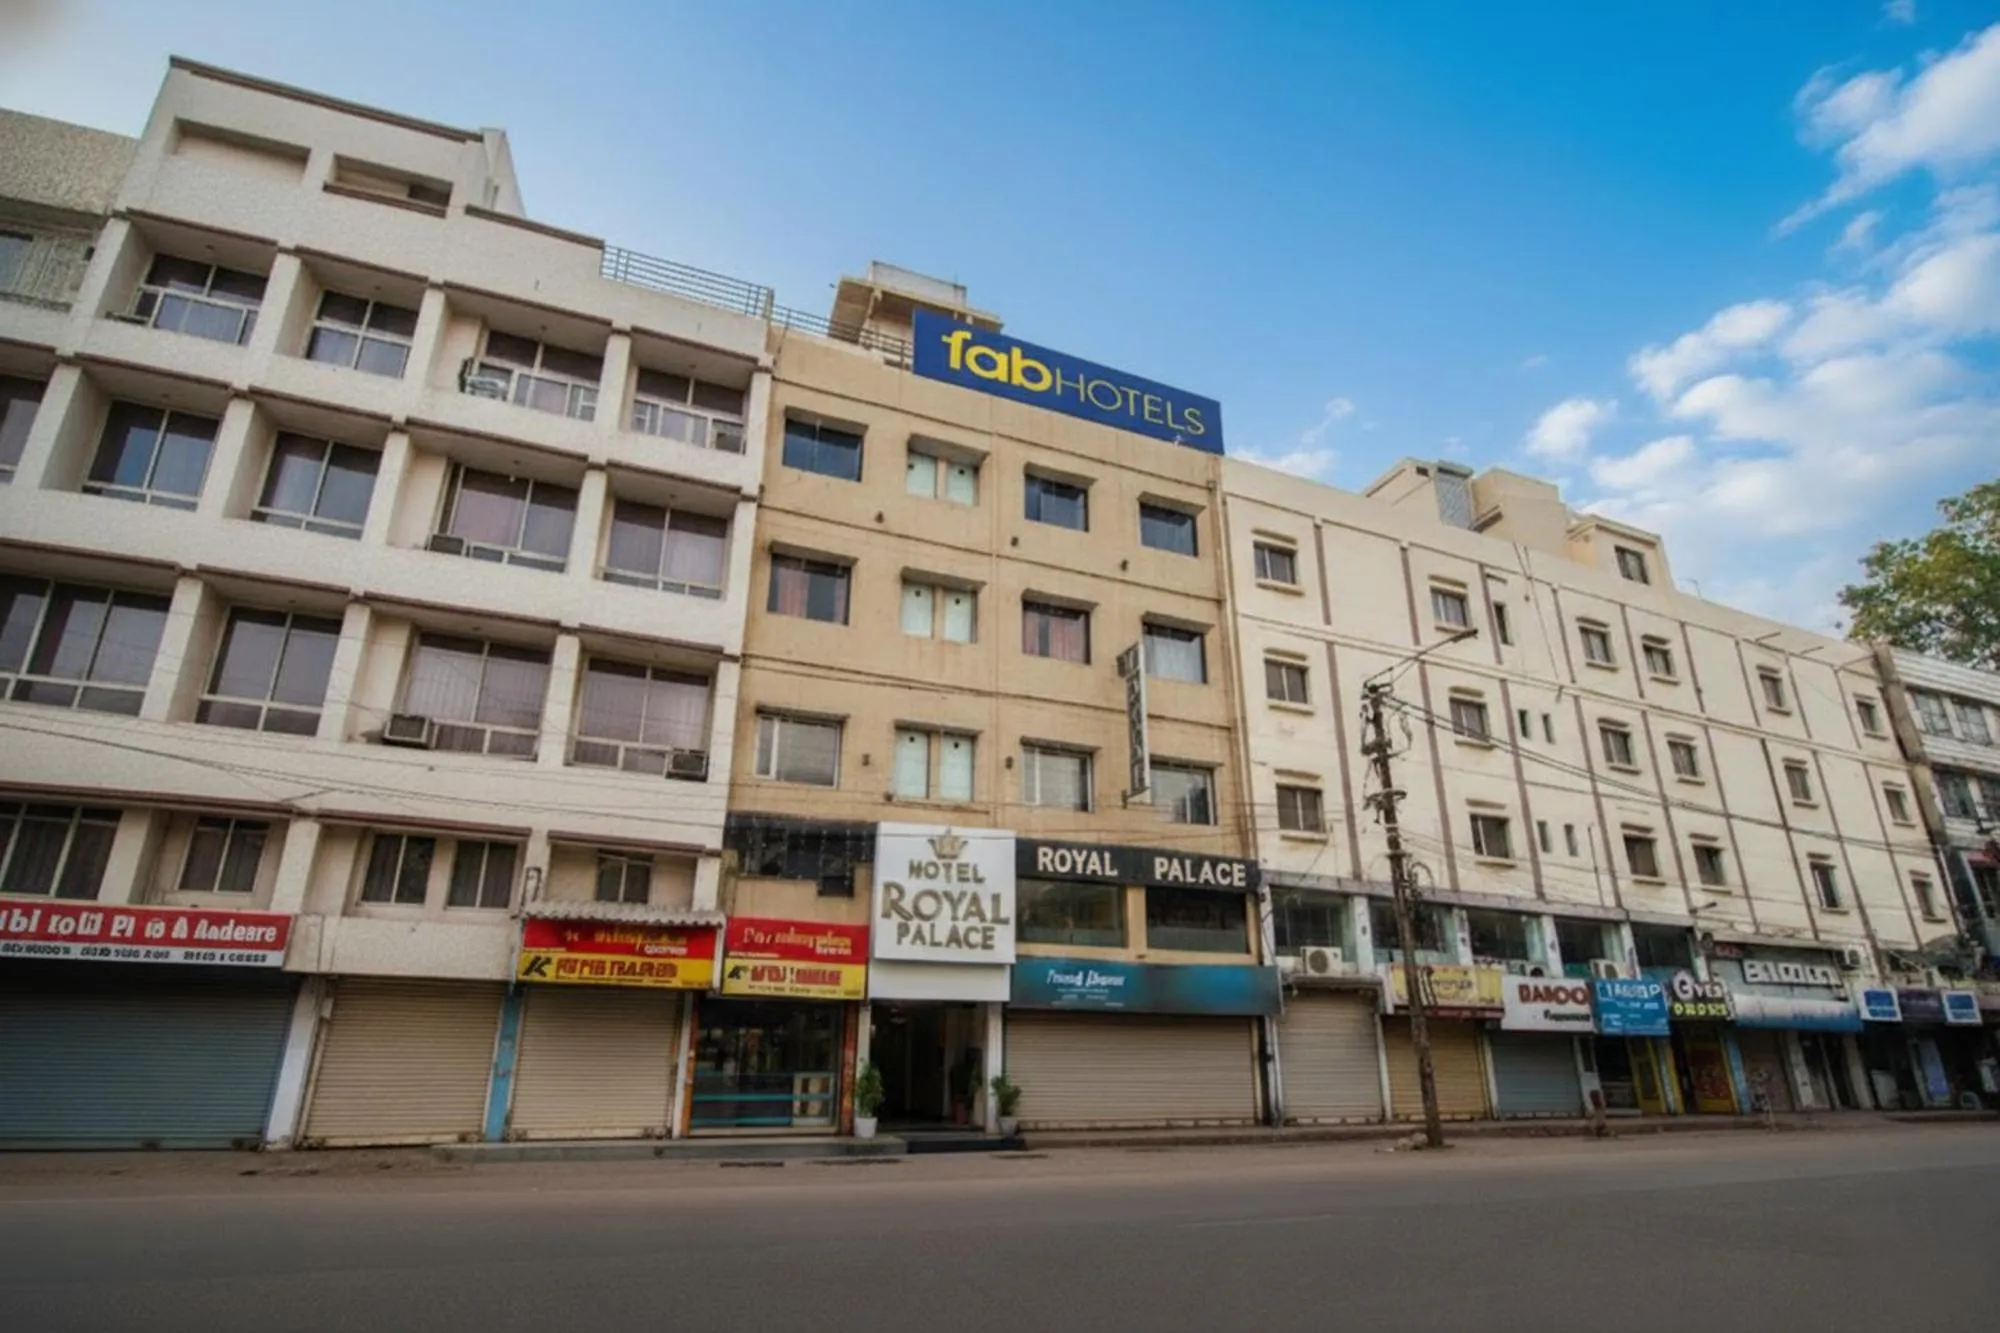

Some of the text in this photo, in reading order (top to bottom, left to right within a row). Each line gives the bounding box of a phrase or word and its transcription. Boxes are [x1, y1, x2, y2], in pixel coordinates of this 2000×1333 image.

[908, 859, 985, 883] HOTEL
[1037, 846, 1247, 887] ROYAL PALACE
[881, 881, 1010, 925] ROYAL
[896, 922, 996, 950] PALACE
